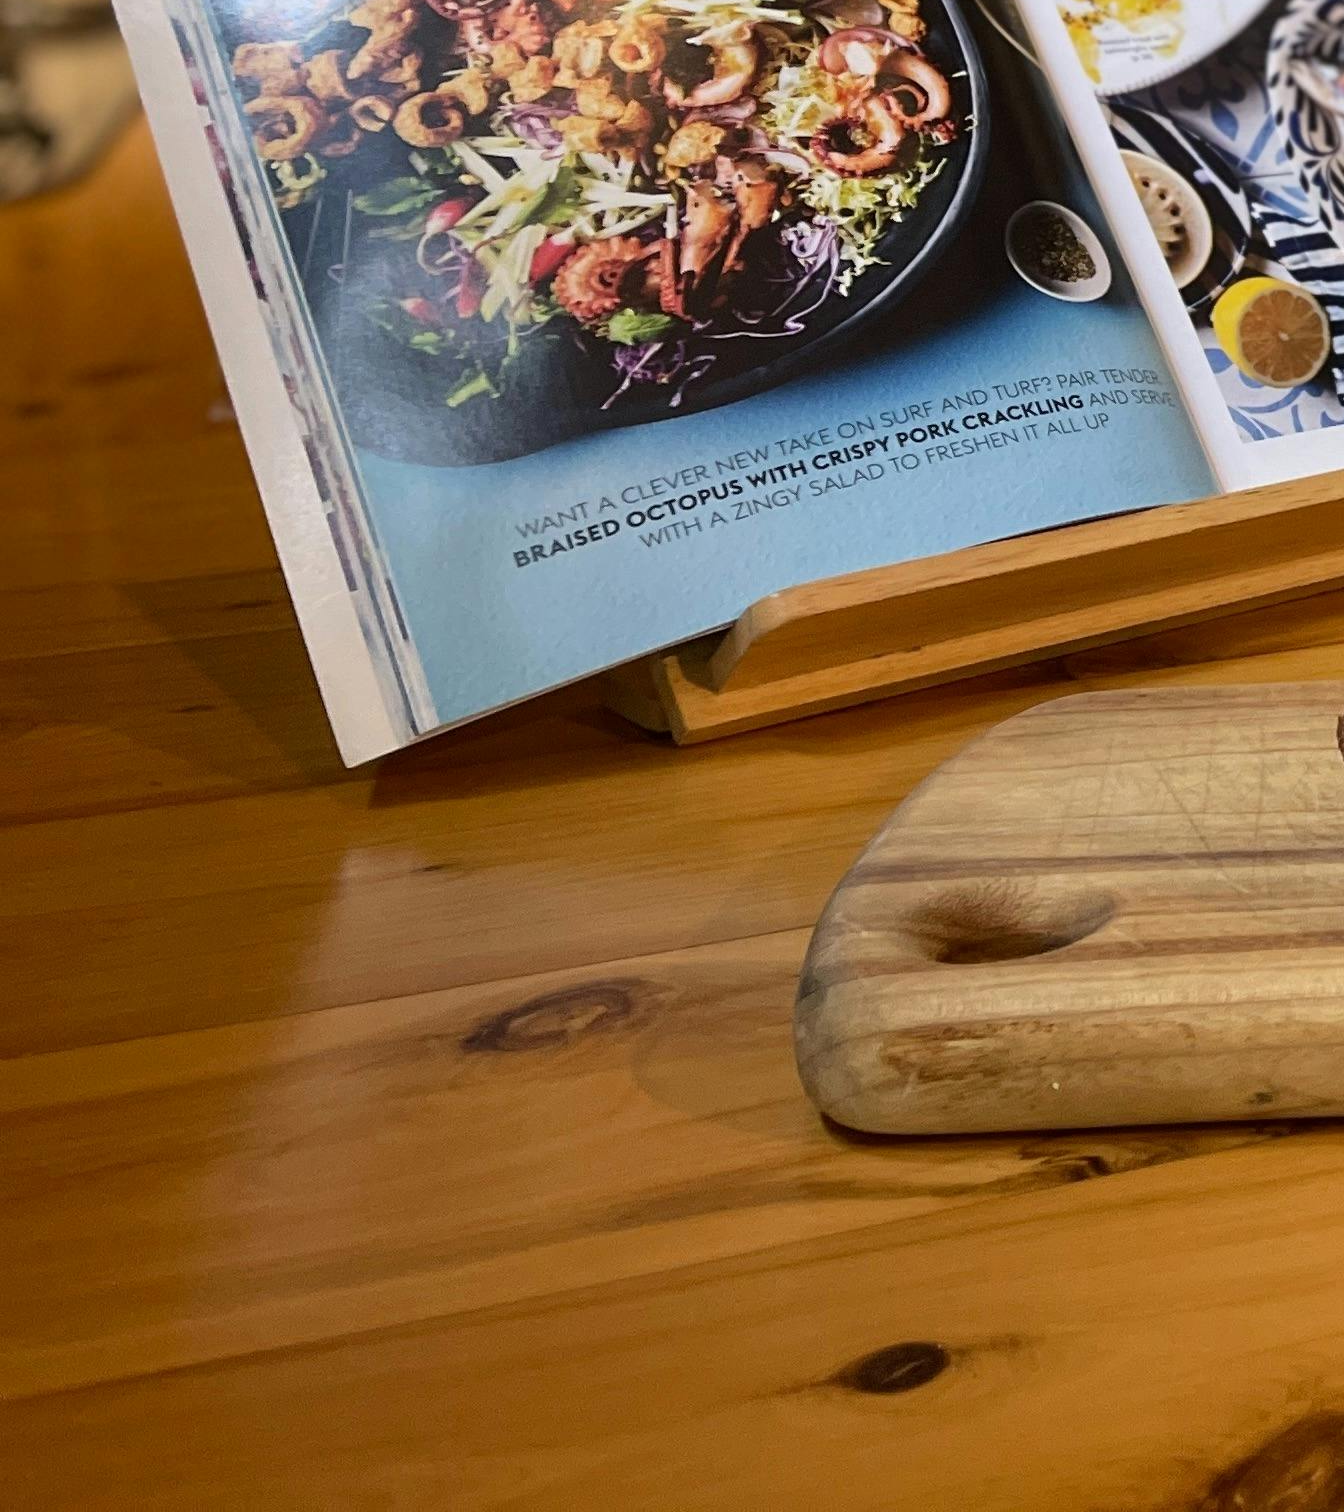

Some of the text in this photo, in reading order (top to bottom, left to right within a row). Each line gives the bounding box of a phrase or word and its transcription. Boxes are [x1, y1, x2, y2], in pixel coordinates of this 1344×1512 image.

[513, 388, 1175, 568] BRAISED OCTOPUS WITH CRISPY PORK CRACKLING AND SERVE
[515, 367, 1159, 538] WANT A CLEVER NEW TAKE ON SURF AND TURF? PAIR TENDER
[639, 412, 1110, 548] WITH A ZINGY SALAD TO FRESHEN IT ALL UP
